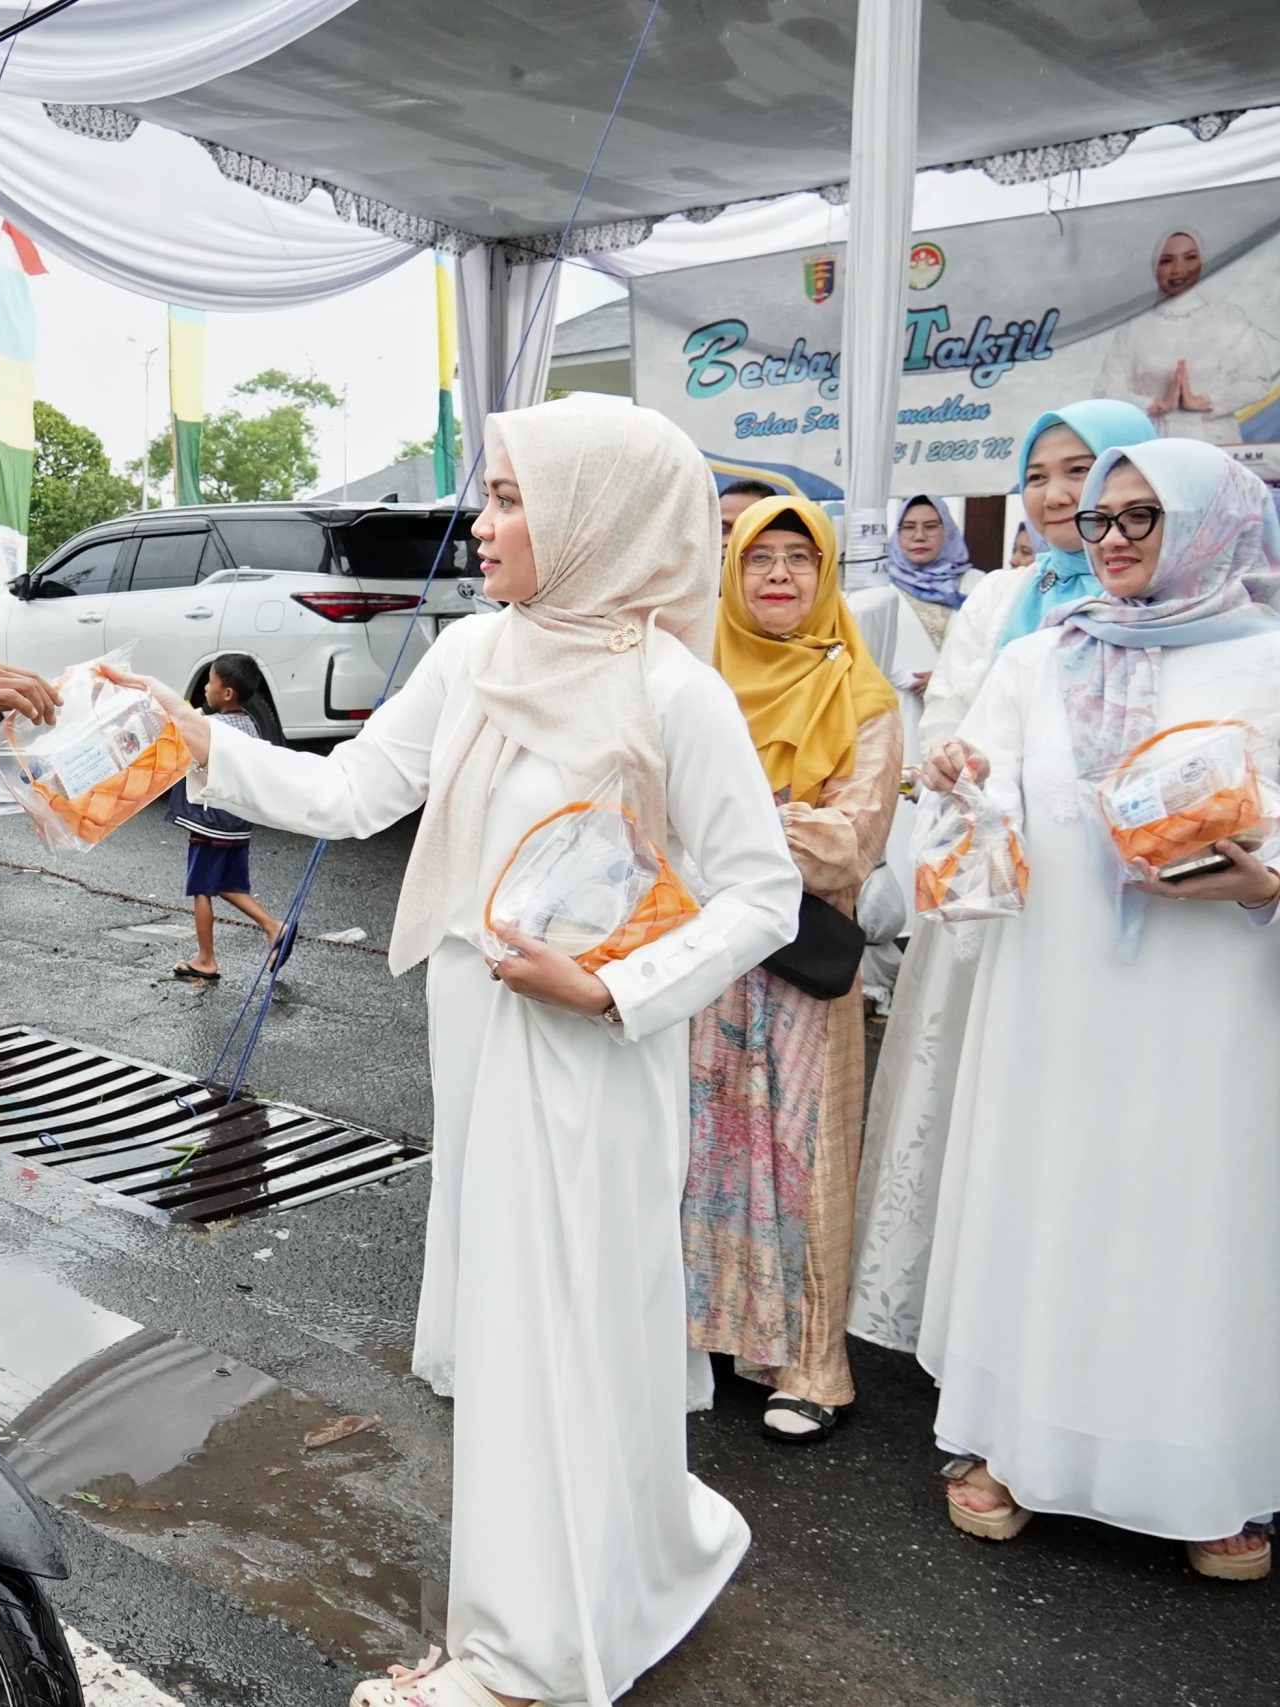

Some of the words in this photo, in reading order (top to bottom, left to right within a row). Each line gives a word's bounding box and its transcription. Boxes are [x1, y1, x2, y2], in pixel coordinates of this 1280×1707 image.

[903, 304, 1060, 389] Takjil
[735, 412, 798, 439] Bulan
[926, 440, 980, 462] 2026
[982, 437, 1014, 459] M
